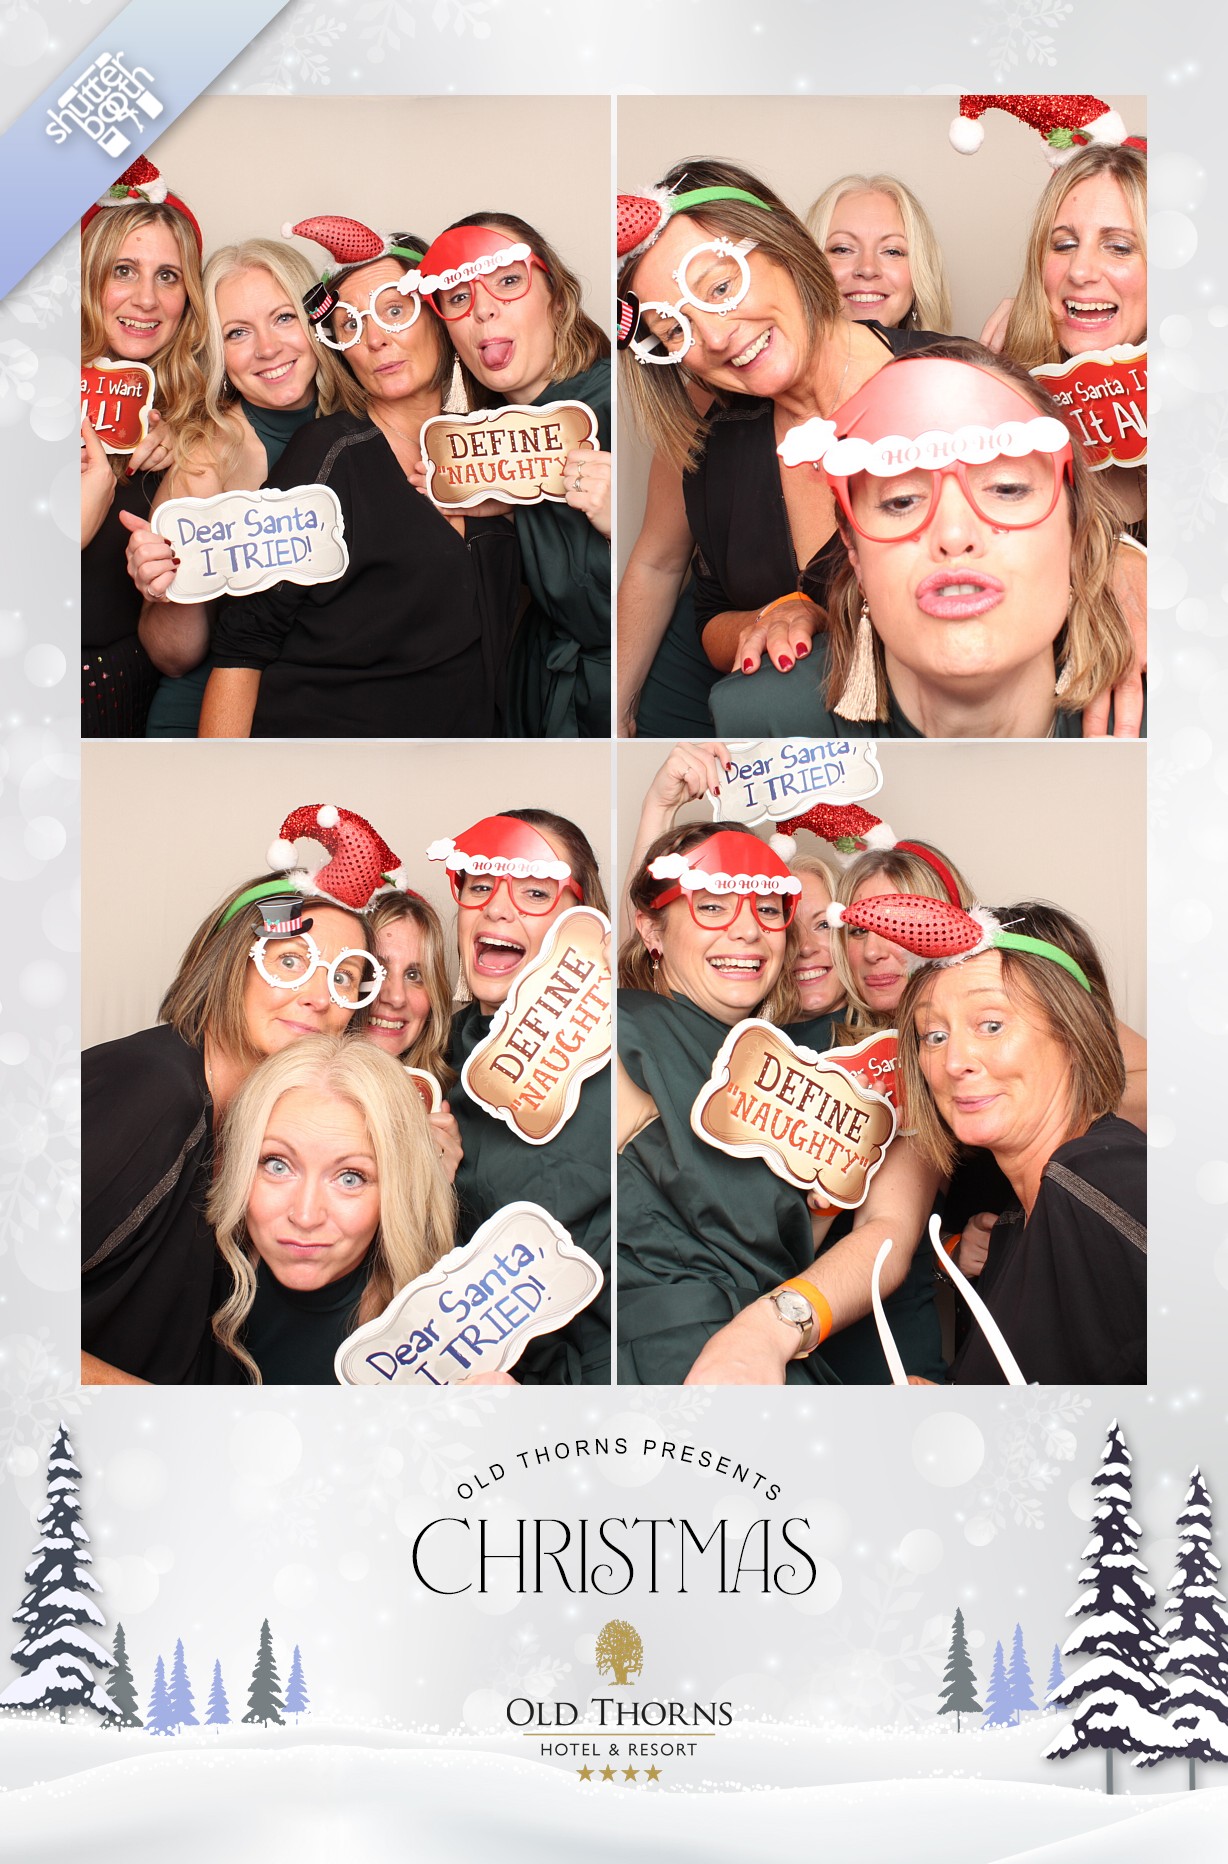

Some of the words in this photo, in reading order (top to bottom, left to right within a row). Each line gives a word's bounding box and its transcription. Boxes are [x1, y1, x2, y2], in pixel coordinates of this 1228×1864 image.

[444, 271, 462, 284] HO
[463, 263, 482, 276] HO
[484, 255, 503, 268] HO
[95, 376, 106, 394] I
[109, 378, 143, 397] Want
[1052, 390, 1074, 406] ear
[1075, 378, 1130, 402] Santa,
[1128, 369, 1145, 391] I
[446, 423, 563, 458] DEFINE
[1069, 408, 1112, 446] It
[881, 446, 921, 465] HO
[926, 439, 967, 458] HO
[972, 433, 1012, 450] HO
[177, 517, 236, 546] Dear
[244, 506, 325, 537] Santa,
[200, 547, 217, 577] I
[223, 535, 312, 573] TRIED!
[725, 757, 774, 784] Dear
[780, 742, 857, 769] Santa,
[743, 782, 758, 807] I
[763, 760, 846, 801] TRIED!
[472, 861, 492, 871] HO
[494, 862, 516, 871] HO
[518, 863, 540, 872] HO
[714, 880, 737, 889] HO
[738, 880, 759, 889] HO
[761, 880, 779, 889] HO
[489, 946, 596, 1084] DEFINE
[753, 1051, 870, 1144] DEFINE
[726, 1082, 869, 1174] "NAUGHTY"
[366, 1319, 440, 1380] Dear
[438, 1243, 545, 1323] Santa,
[415, 1361, 449, 1385] I
[439, 1275, 552, 1369] TRIED!
